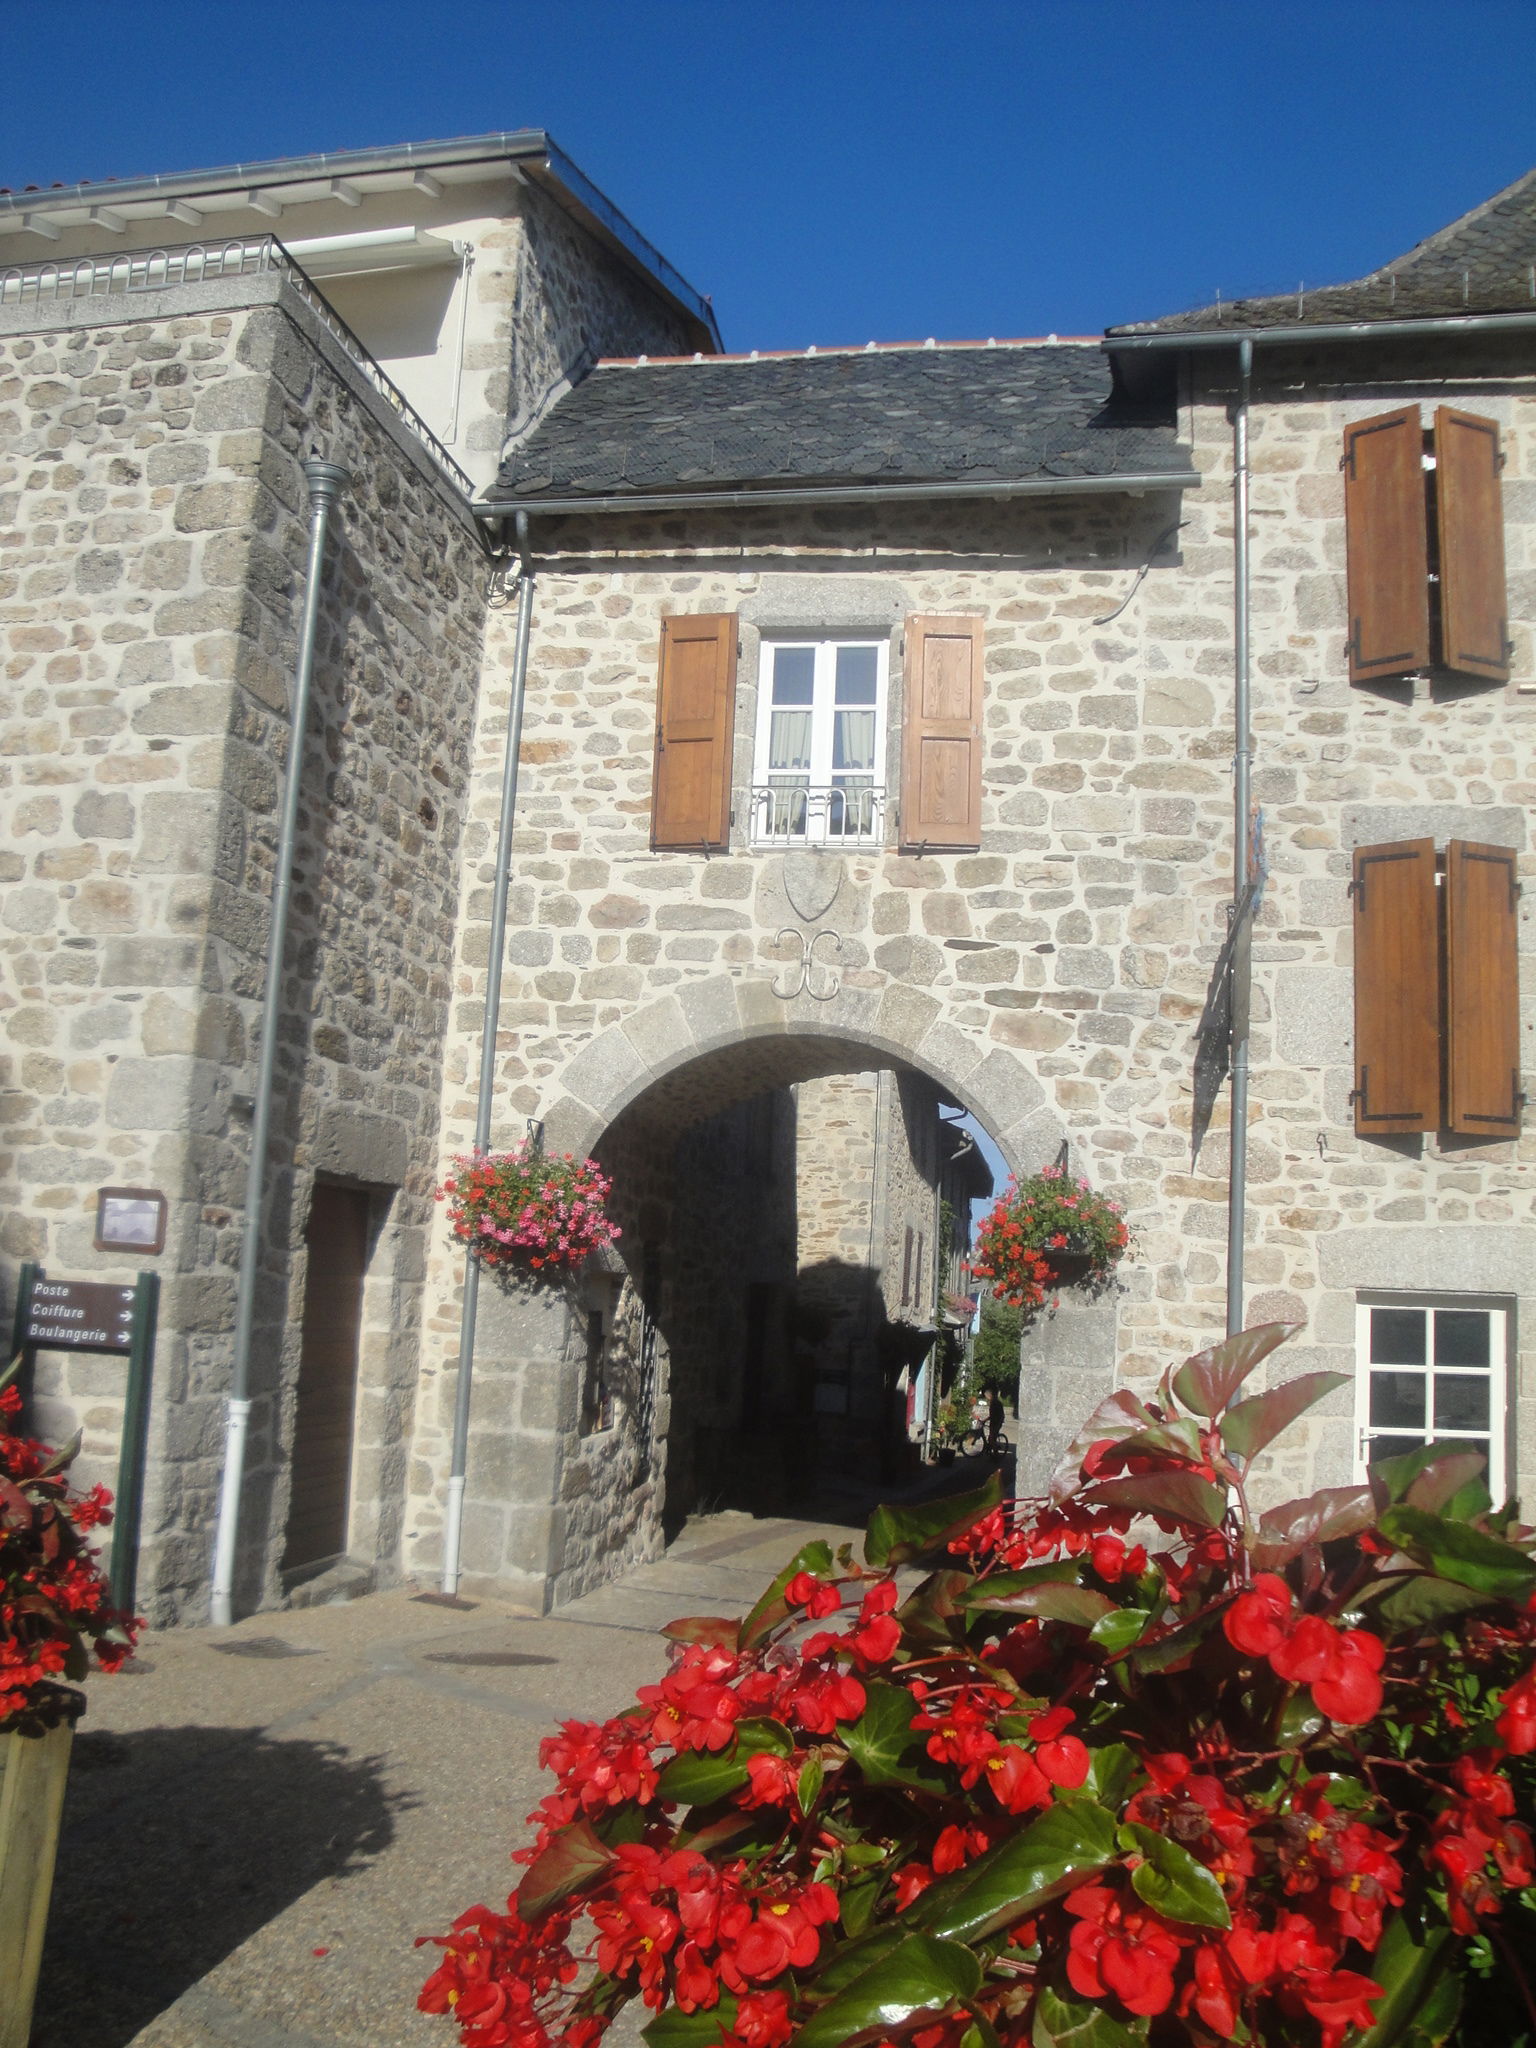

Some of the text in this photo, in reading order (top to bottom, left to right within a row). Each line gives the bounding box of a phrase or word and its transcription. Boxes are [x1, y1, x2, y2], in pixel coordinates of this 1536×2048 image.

[34, 1283, 69, 1297] Poste
[32, 1303, 84, 1319] Coiffure
[30, 1324, 107, 1342] Boulangerie
